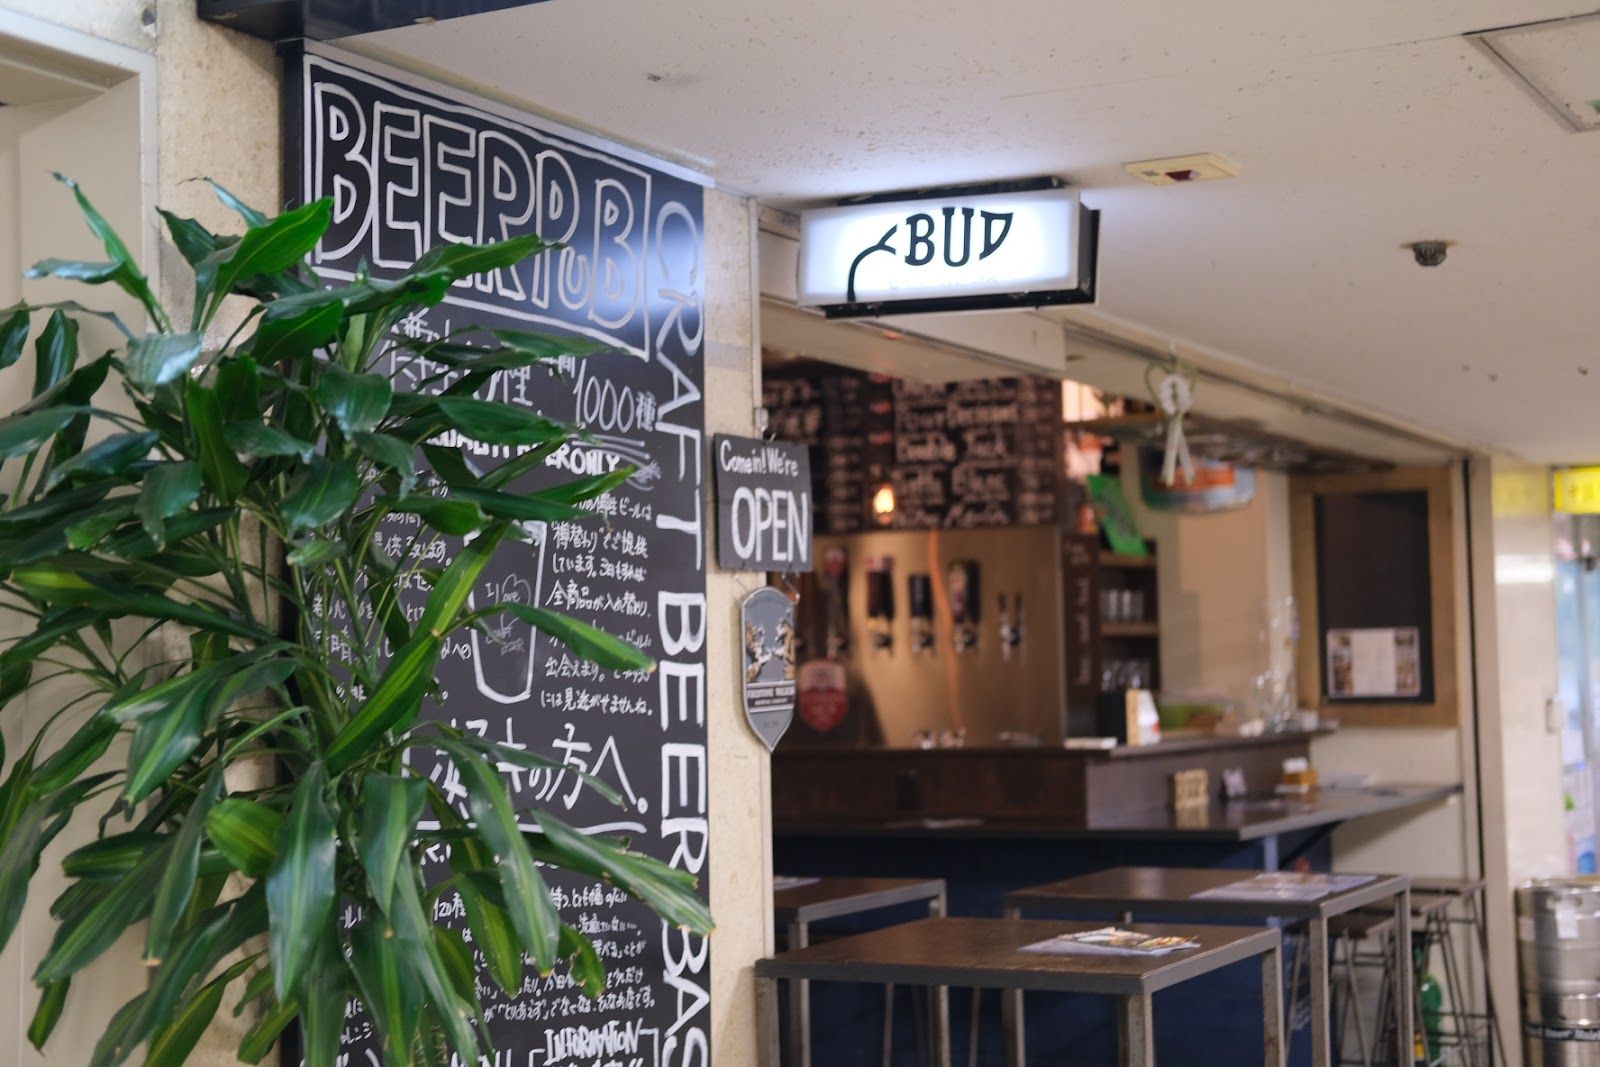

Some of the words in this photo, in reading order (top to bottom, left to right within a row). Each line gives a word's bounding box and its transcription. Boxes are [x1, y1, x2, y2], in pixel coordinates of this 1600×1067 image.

[904, 206, 1013, 267] BUD
[655, 200, 704, 571] CRAFT
[720, 439, 753, 474] Come
[766, 447, 799, 477] We're
[731, 486, 807, 563] OPEN
[658, 590, 710, 874] BEER
[543, 1017, 645, 1066] INFORMATION
